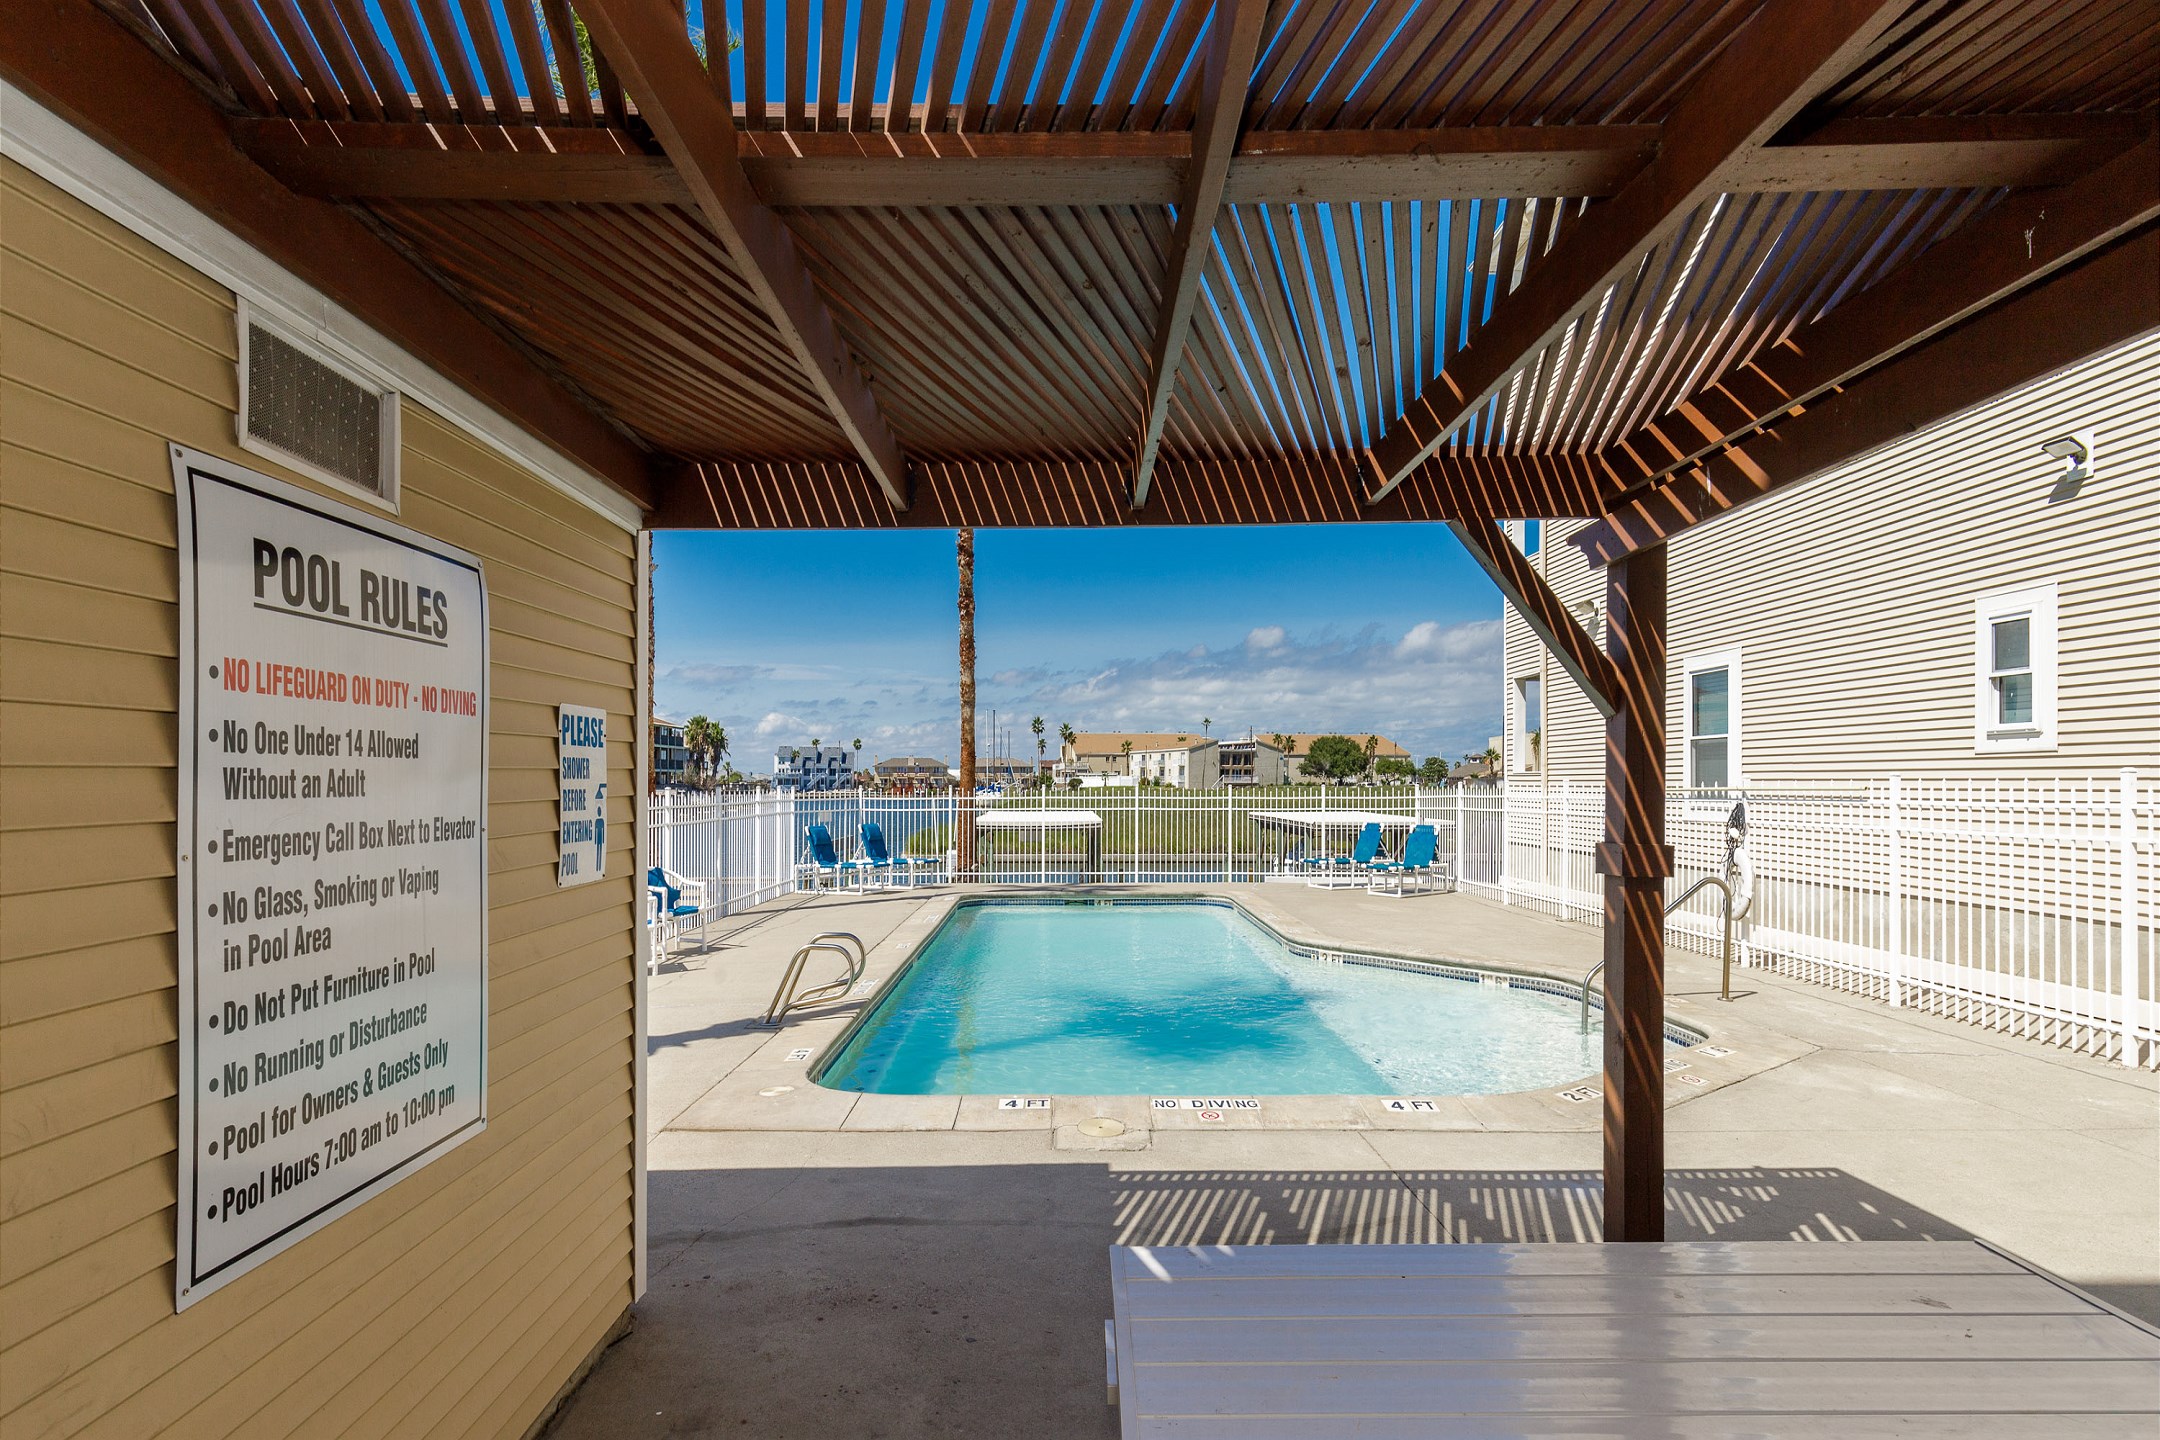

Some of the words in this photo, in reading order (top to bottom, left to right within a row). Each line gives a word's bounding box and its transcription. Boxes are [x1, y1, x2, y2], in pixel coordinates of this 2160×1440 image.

[253, 537, 350, 617] POOL
[361, 568, 448, 640] RULES
[223, 657, 250, 693] NO
[256, 661, 347, 703] LIFEGUARD
[352, 673, 371, 705] ON
[376, 678, 410, 710] DUTY
[422, 685, 439, 713] NO
[441, 687, 476, 717] DIVING
[223, 719, 248, 754] No
[255, 721, 289, 756] One
[295, 724, 341, 757] Under
[345, 730, 363, 757] 14
[368, 732, 419, 759] Allowed
[562, 714, 603, 748] PLEASE
[223, 766, 296, 800] Without
[302, 772, 321, 799] an
[327, 768, 366, 798] Adult
[563, 757, 590, 779] SHOWER
[563, 789, 586, 811] BEFORE
[223, 825, 320, 865] Emergency
[325, 821, 354, 854] Call
[359, 821, 384, 850] Box
[387, 819, 416, 847] Next
[419, 818, 430, 844] to
[434, 816, 476, 842] Elevator
[563, 820, 593, 844] ENTERING
[561, 852, 578, 876] POOL
[222, 889, 248, 926] No
[254, 885, 308, 921] Glass,
[314, 874, 377, 911] Smoking
[381, 874, 394, 899] or
[399, 865, 439, 897] Vaping
[223, 939, 242, 972] in
[248, 928, 288, 968] Pool
[294, 926, 332, 957] Area
[224, 1000, 248, 1036] Do
[254, 988, 285, 1028] Not
[291, 979, 318, 1016] Put
[323, 965, 389, 1005] Furniture
[394, 959, 405, 985] in
[409, 948, 435, 980] Pool
[224, 1062, 248, 1098] No
[254, 1036, 324, 1087] Running
[329, 1030, 344, 1057] or
[349, 1003, 427, 1052] Disturbance
[224, 1111, 266, 1161] Pool
[272, 1102, 296, 1139] for
[302, 1080, 358, 1125] Owners
[363, 1072, 373, 1098] &
[377, 1051, 421, 1091] Guests
[424, 1039, 449, 1081] Only
[1004, 1100, 1018, 1108] 4
[1027, 1100, 1049, 1108] FT
[1154, 1100, 1176, 1108] NO
[1191, 1100, 1259, 1108] DIVING
[1391, 1101, 1405, 1110] 4
[1411, 1101, 1433, 1110] FT
[1562, 1092, 1583, 1101] 2
[1575, 1087, 1600, 1098] FT
[222, 1171, 265, 1224] Pool
[271, 1151, 319, 1198] Hours
[324, 1132, 357, 1170] 7:00
[361, 1121, 382, 1150] am
[385, 1110, 398, 1138] to
[402, 1089, 435, 1128] 10:00
[438, 1083, 455, 1115] pm
